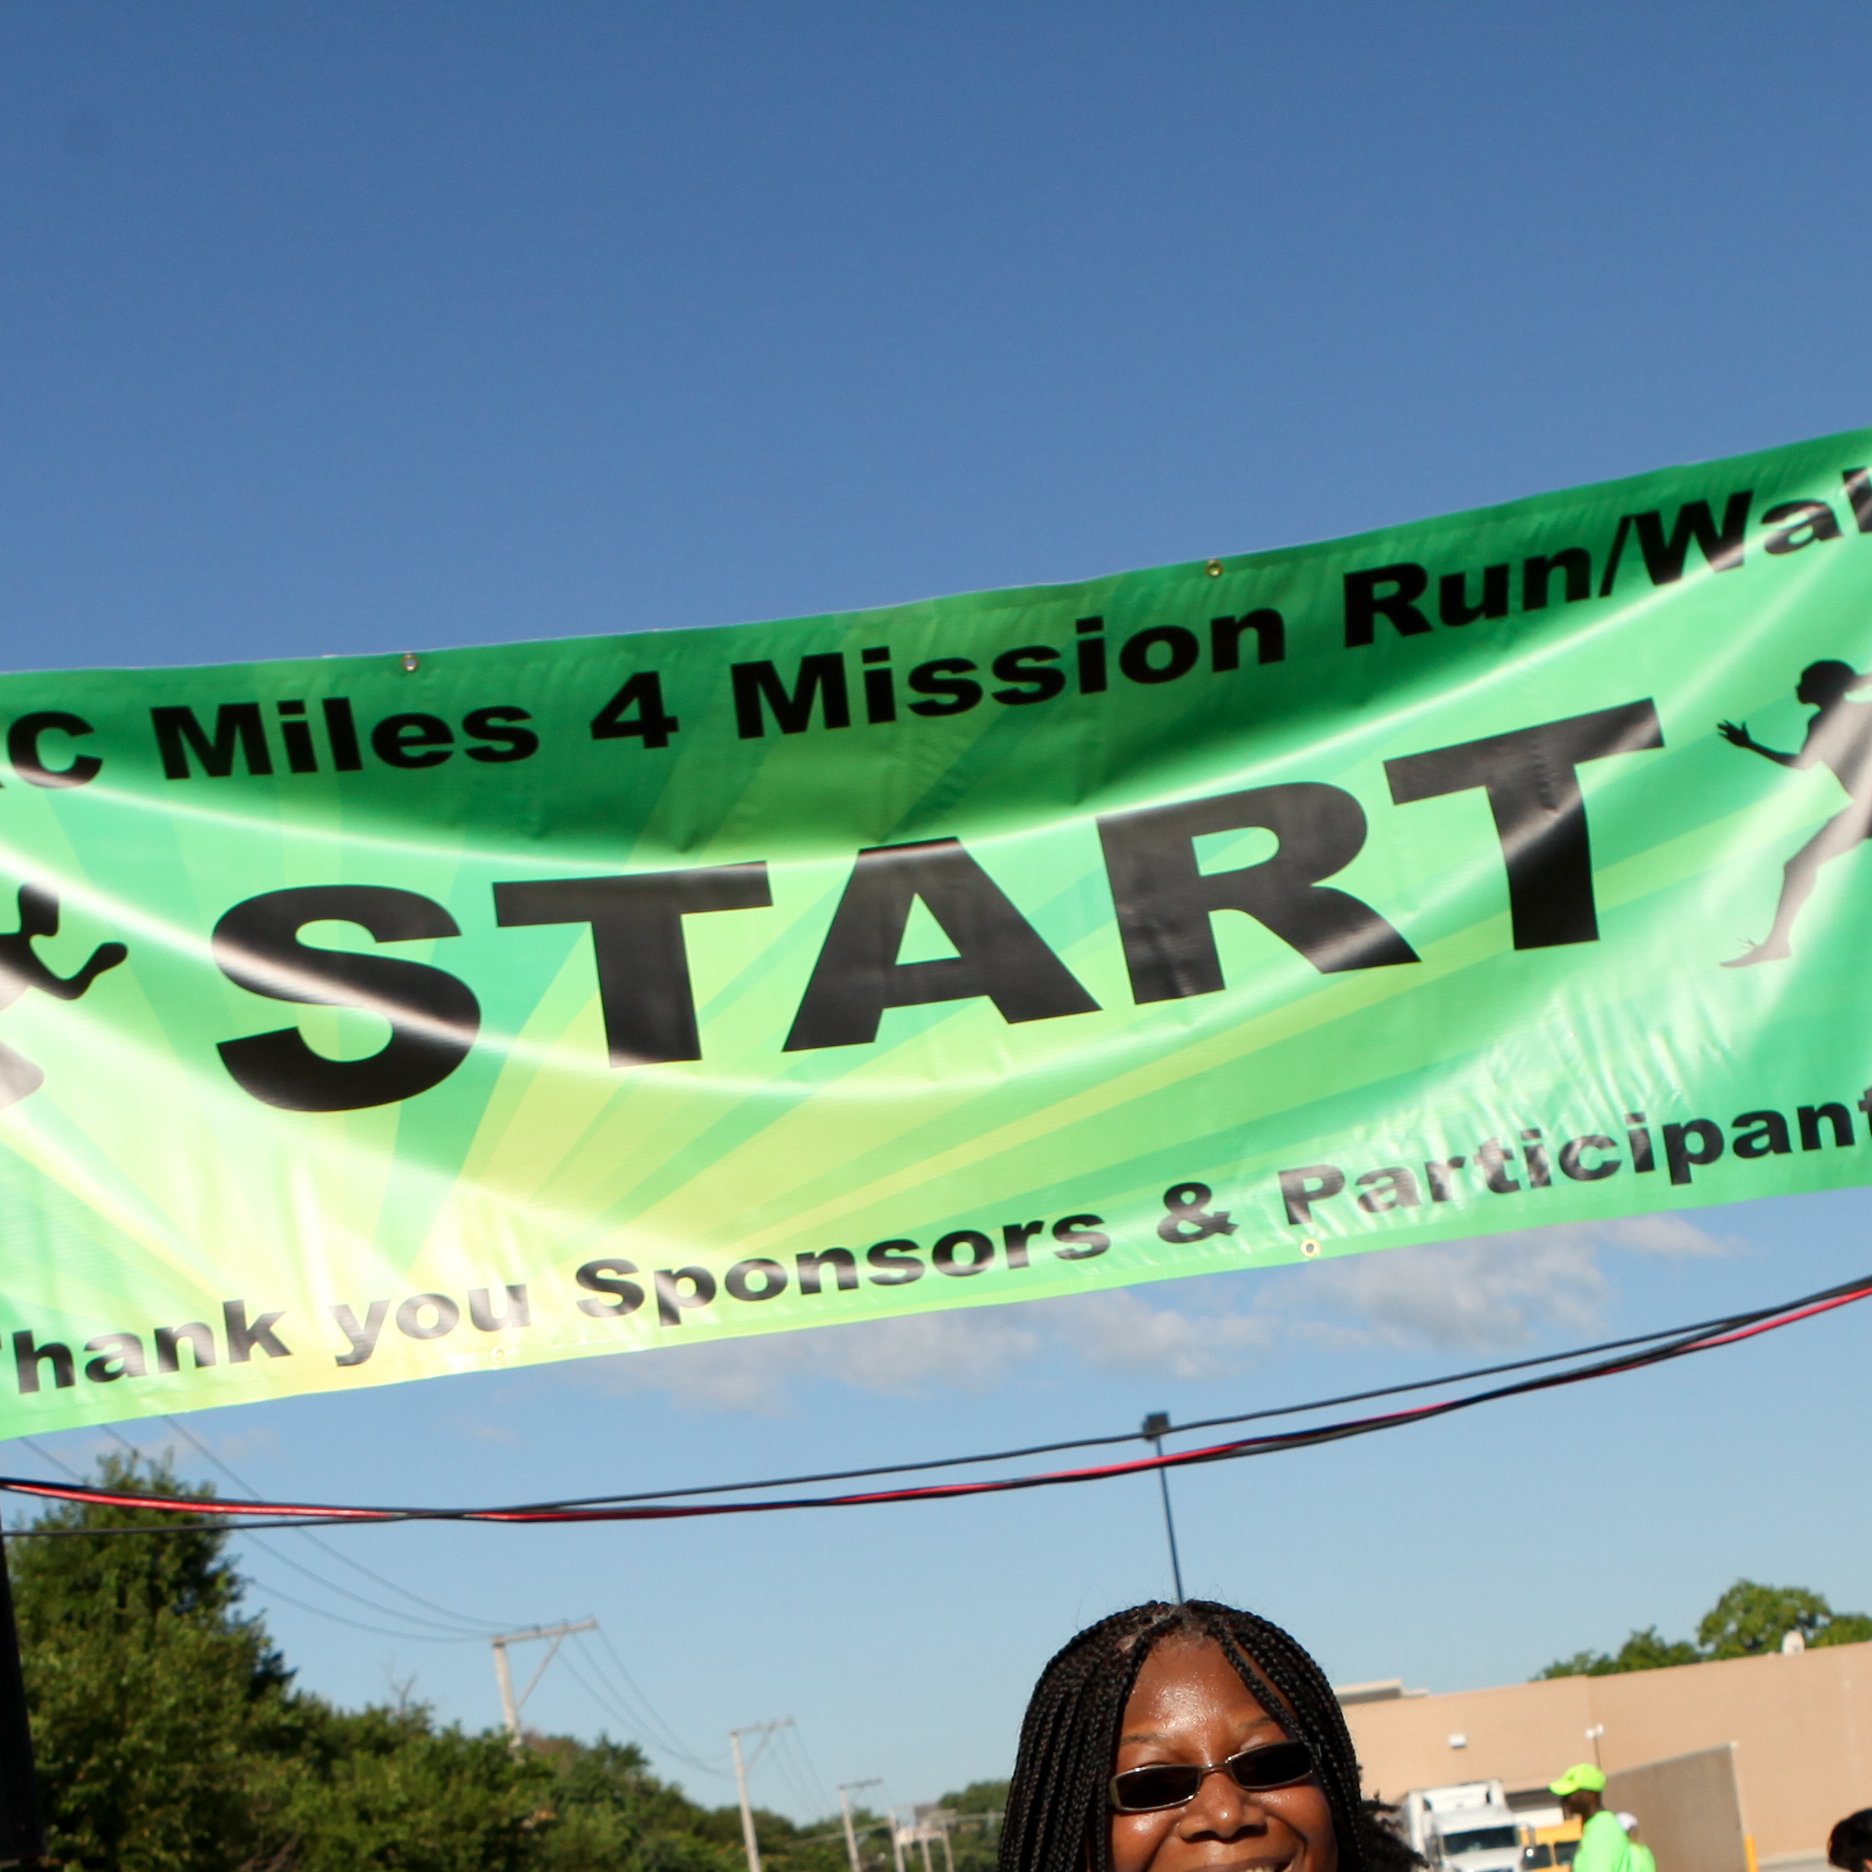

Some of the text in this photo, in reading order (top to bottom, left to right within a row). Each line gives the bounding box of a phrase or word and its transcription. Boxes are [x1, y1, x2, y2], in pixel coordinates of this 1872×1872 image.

[149, 695, 540, 780] Miles
[589, 670, 680, 750] 4
[731, 604, 1286, 741] Mission
[210, 697, 1664, 1113] START
[327, 1279, 530, 1366] you
[573, 1213, 1112, 1325] Sponsors
[1156, 1181, 1238, 1244] &
